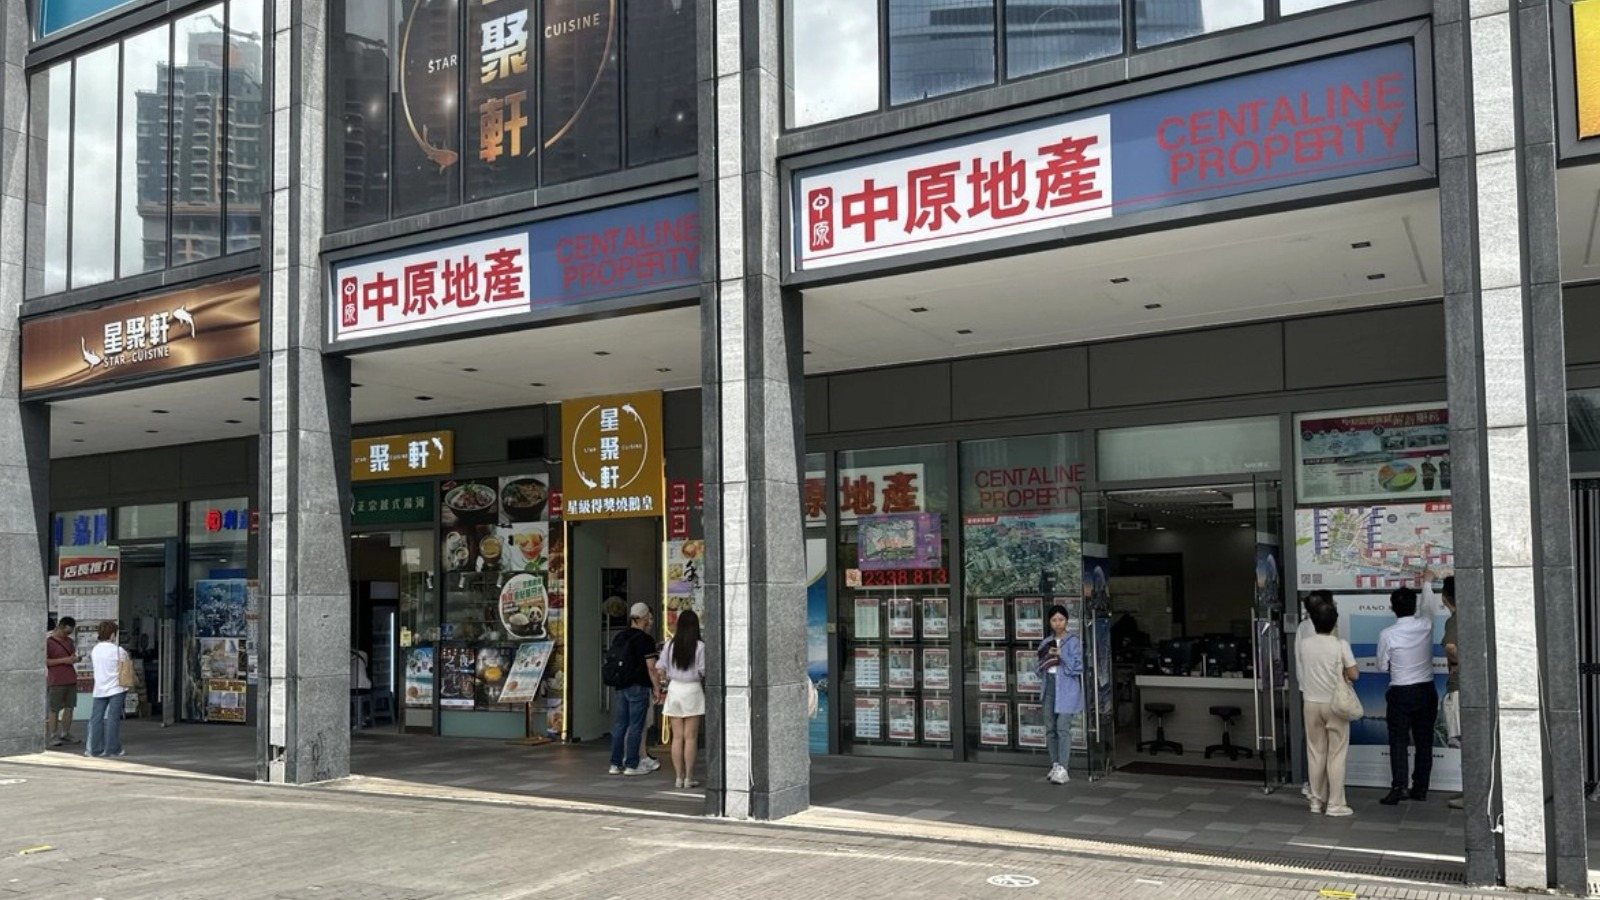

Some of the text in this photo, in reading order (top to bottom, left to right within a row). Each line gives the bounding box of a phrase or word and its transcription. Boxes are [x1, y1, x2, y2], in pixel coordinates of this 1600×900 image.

[544, 12, 601, 39] CUISINE
[427, 53, 458, 73] STAR
[479, 0, 528, 163] 聚軒
[1156, 72, 1405, 154] CENTALINE
[1168, 113, 1404, 187] PROPERTY
[840, 134, 1102, 243] 中原地產
[362, 247, 525, 322] 中原地產
[103, 310, 171, 356] 星聚軒
[103, 345, 170, 368] STAR CUISINE
[600, 407, 620, 489] 星聚軒
[975, 464, 1085, 489] CENTALINE
[980, 487, 1082, 509] PROPERTY
